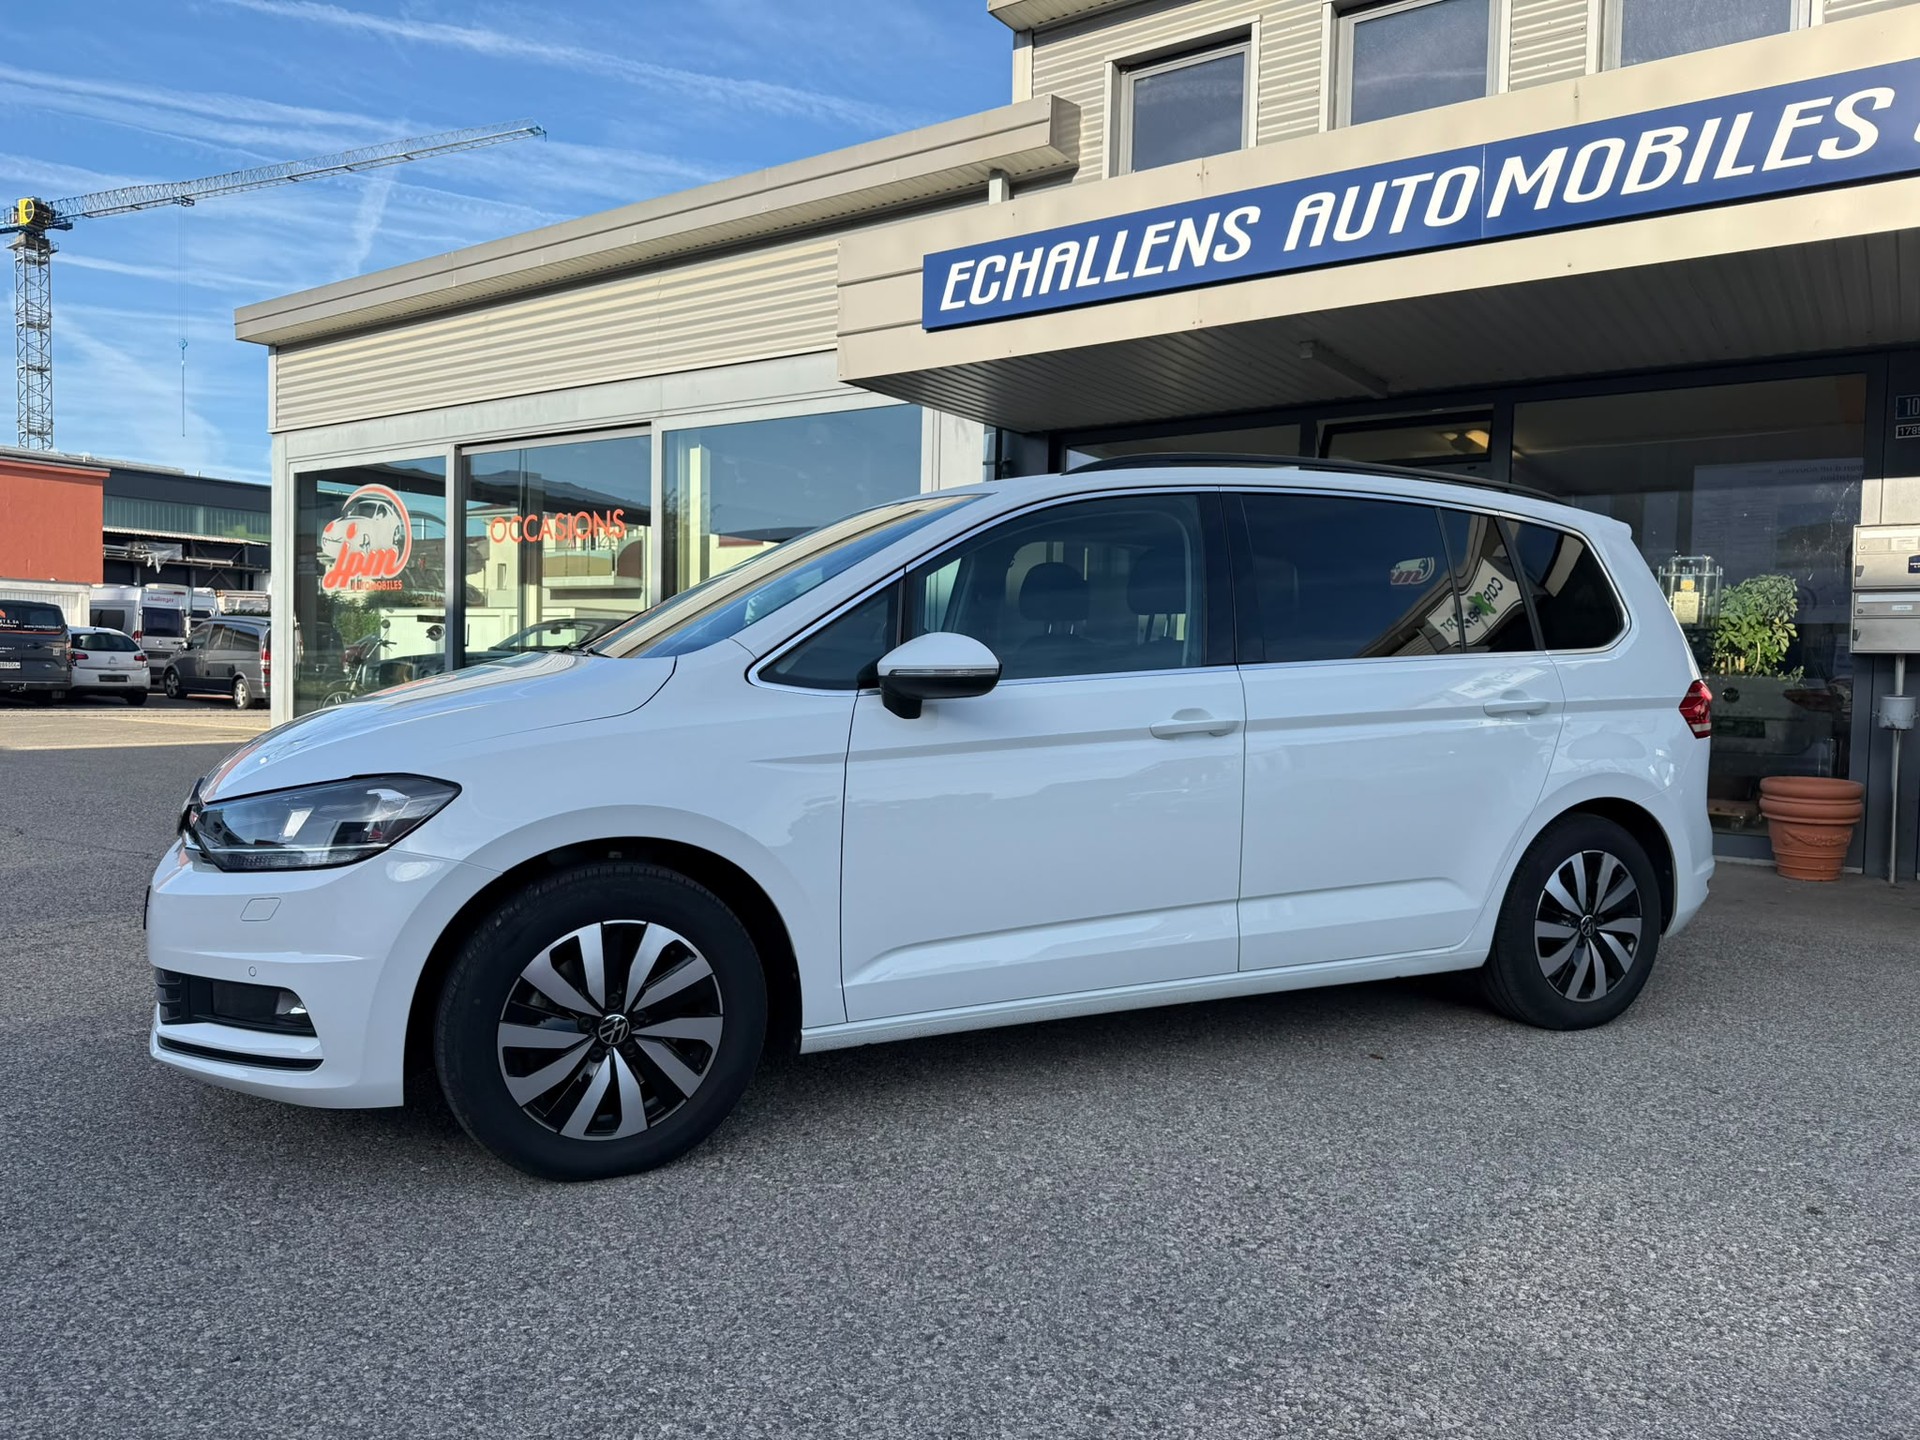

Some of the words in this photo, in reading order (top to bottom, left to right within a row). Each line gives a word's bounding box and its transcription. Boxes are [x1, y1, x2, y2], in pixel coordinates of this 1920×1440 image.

[940, 206, 1261, 312] ECHALLENS
[490, 509, 626, 543] OCCASIONS
[349, 579, 403, 591] AUTOMOBILES
